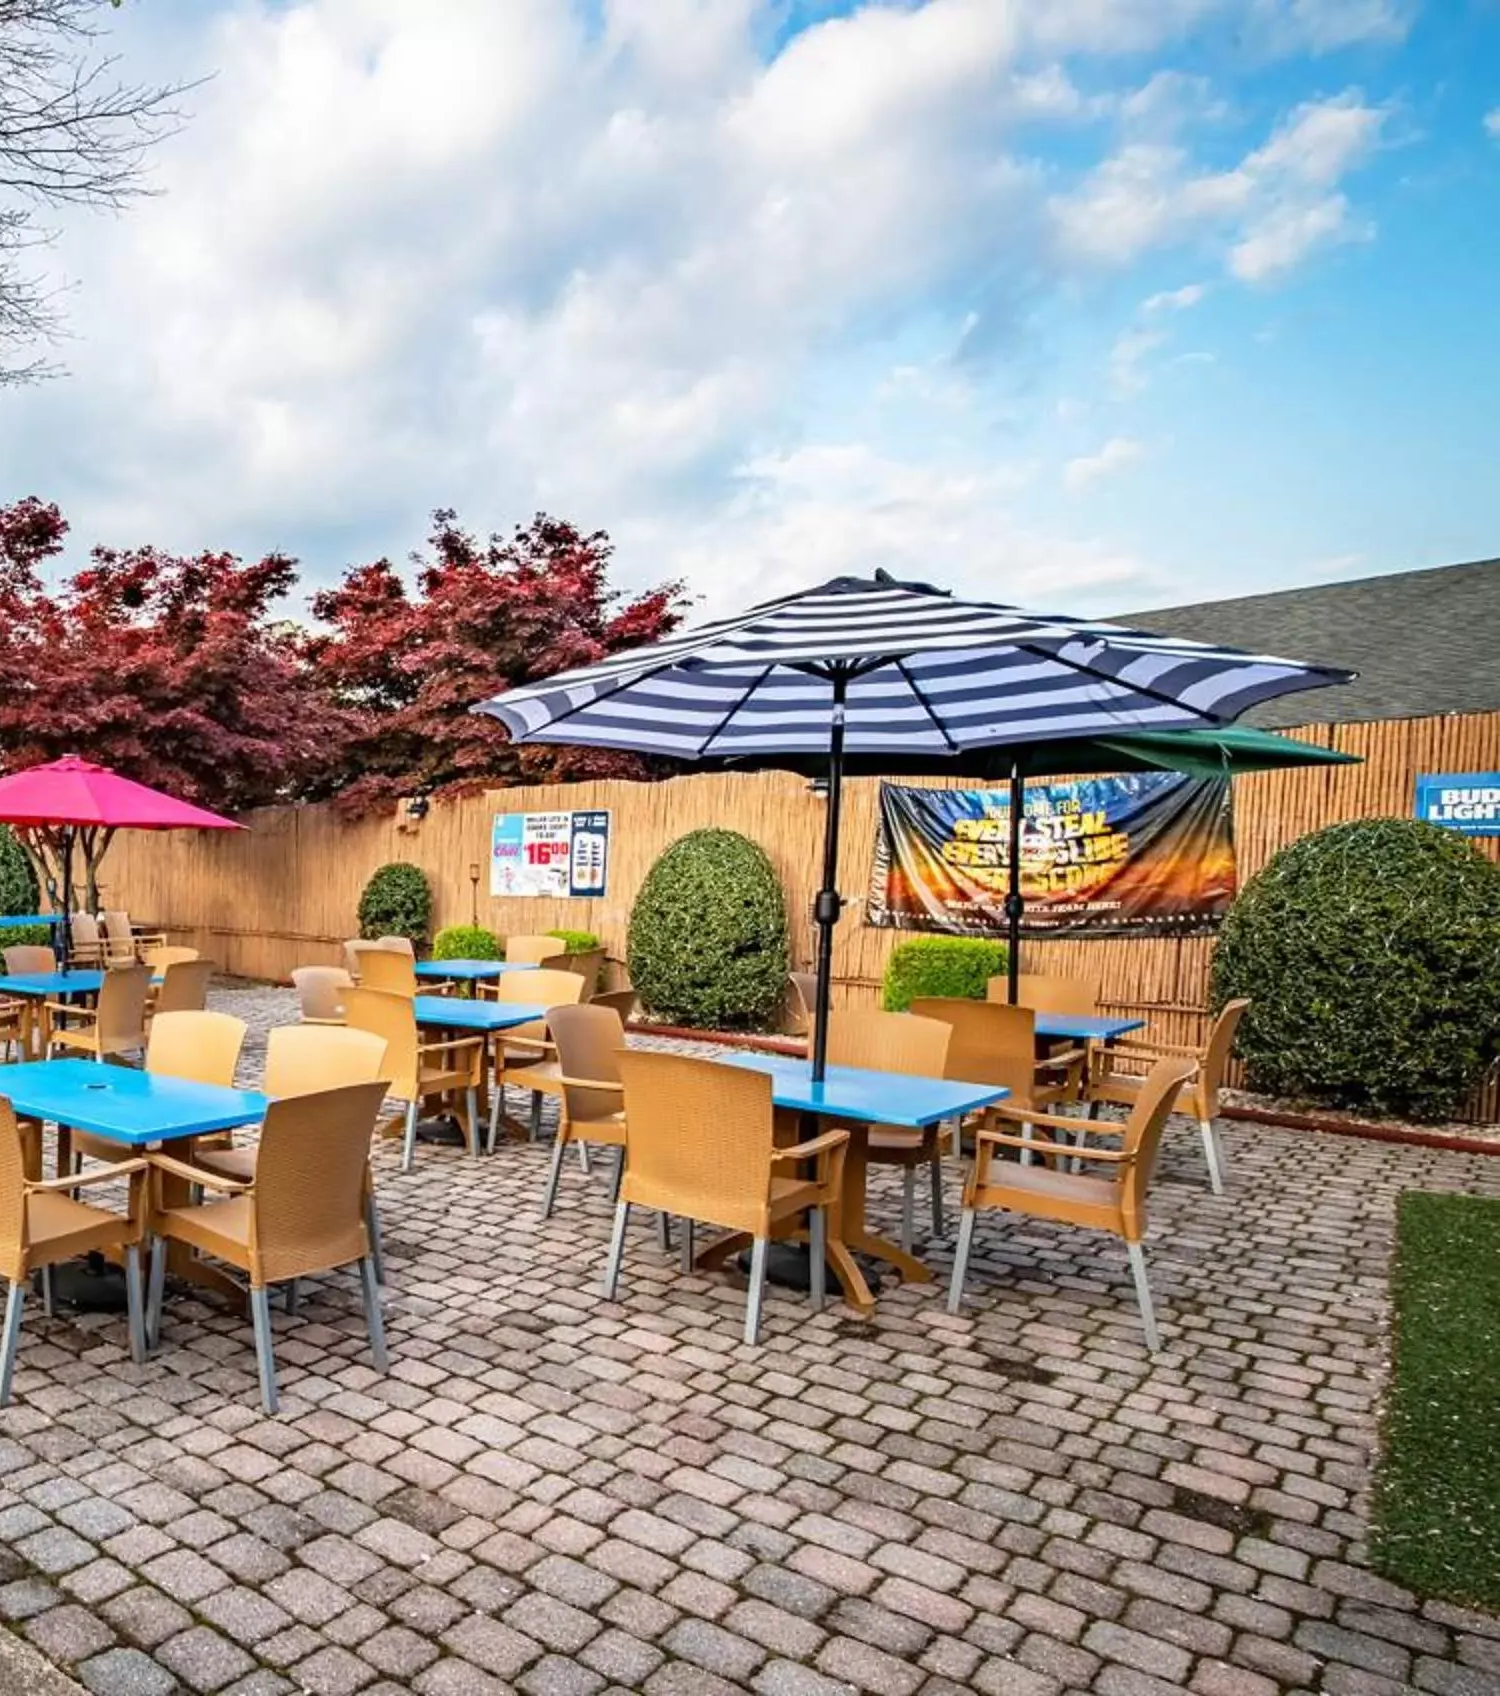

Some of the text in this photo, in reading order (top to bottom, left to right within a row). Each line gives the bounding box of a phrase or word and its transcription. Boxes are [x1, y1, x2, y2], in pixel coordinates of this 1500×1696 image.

[1441, 788, 1500, 804] BUD
[1036, 811, 1111, 838] STEAL
[941, 832, 1129, 866] EVERY SLIDE
